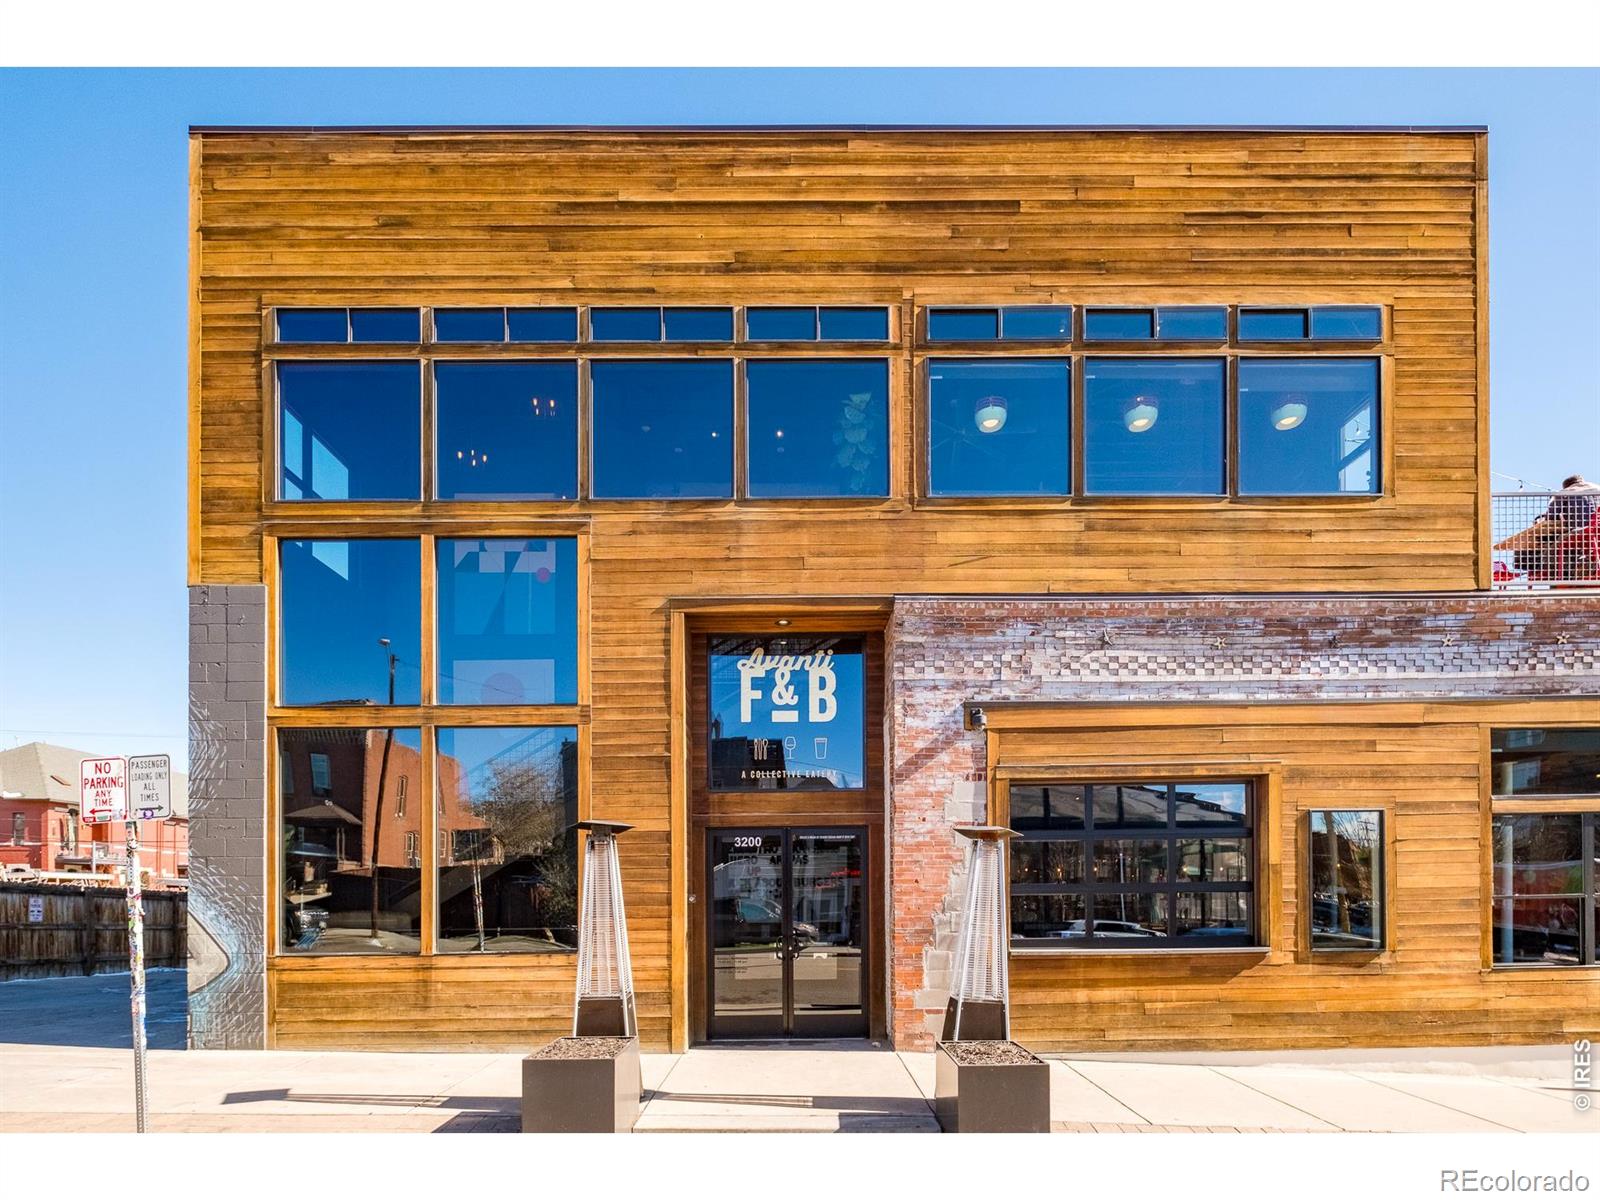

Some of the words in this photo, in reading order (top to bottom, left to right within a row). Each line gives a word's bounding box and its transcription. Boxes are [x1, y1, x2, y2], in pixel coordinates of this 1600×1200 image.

[736, 647, 834, 672] Avanti
[740, 669, 766, 723] F
[771, 669, 799, 706] &
[808, 668, 838, 723] B
[94, 762, 111, 775] NO
[131, 760, 168, 770] PASSENGER
[131, 772, 153, 782] LOADING
[155, 771, 168, 780] ONLY
[741, 770, 746, 779] A
[750, 770, 801, 779] COLLECTIVE
[83, 776, 124, 790] PARKING
[143, 782, 156, 791] ALL
[95, 790, 112, 798] ANY
[140, 793, 160, 802] TIMES
[94, 798, 113, 807] TIME
[734, 836, 762, 848] 3200
